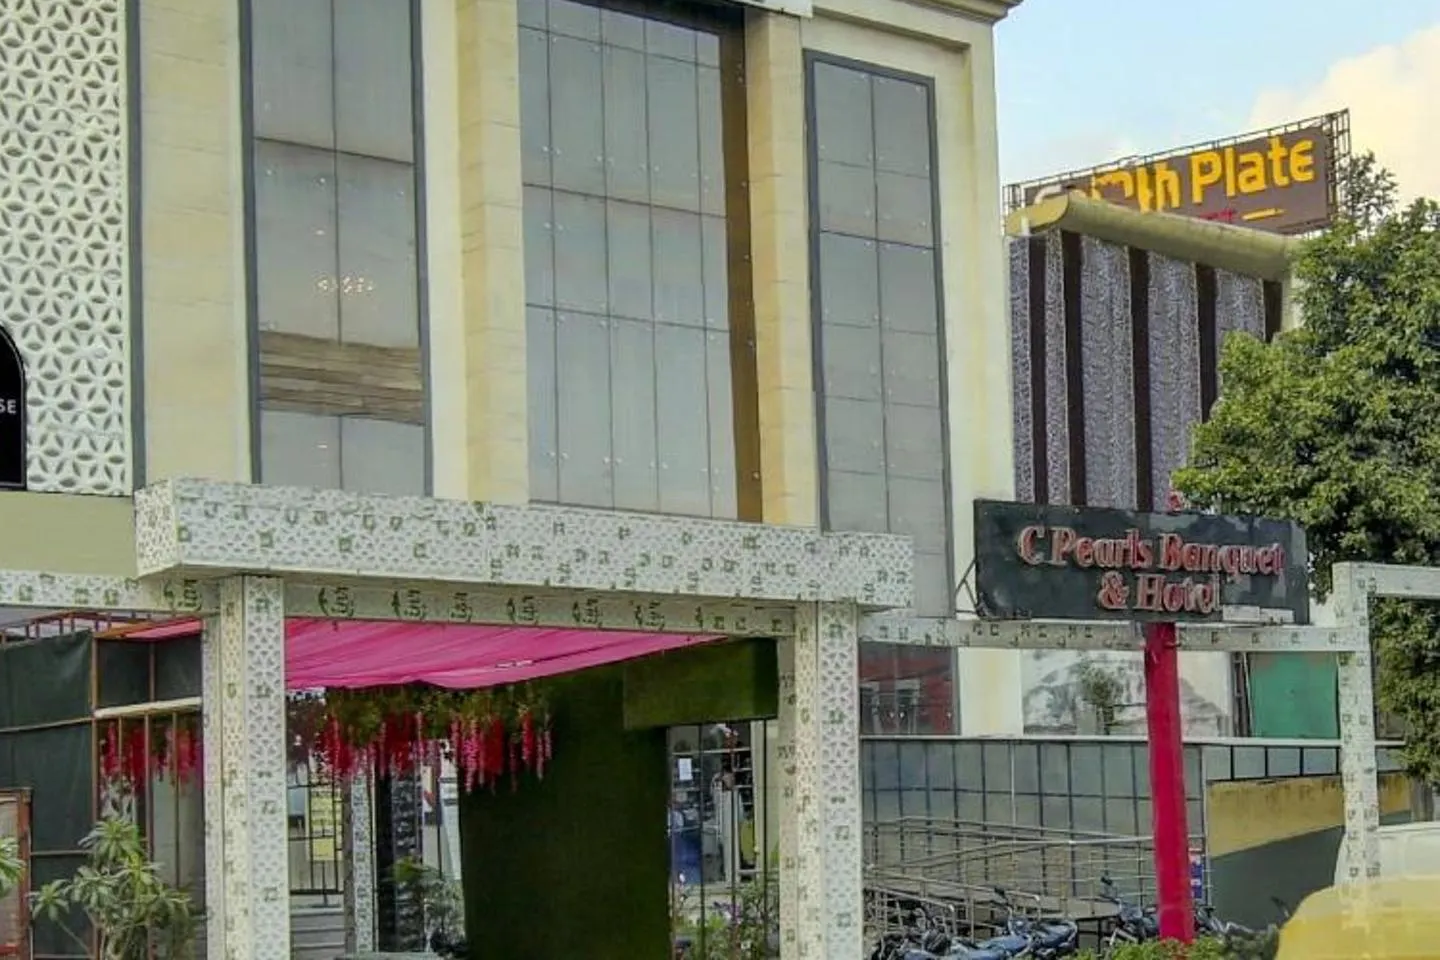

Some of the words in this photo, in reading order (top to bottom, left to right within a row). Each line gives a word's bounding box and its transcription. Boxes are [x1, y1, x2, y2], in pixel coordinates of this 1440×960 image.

[1190, 136, 1314, 205] Plate
[1018, 525, 1047, 566] C
[1048, 526, 1155, 570] Pearls
[1158, 532, 1289, 577] Banquet
[1096, 569, 1131, 611] &
[1136, 572, 1223, 615] Hotel
